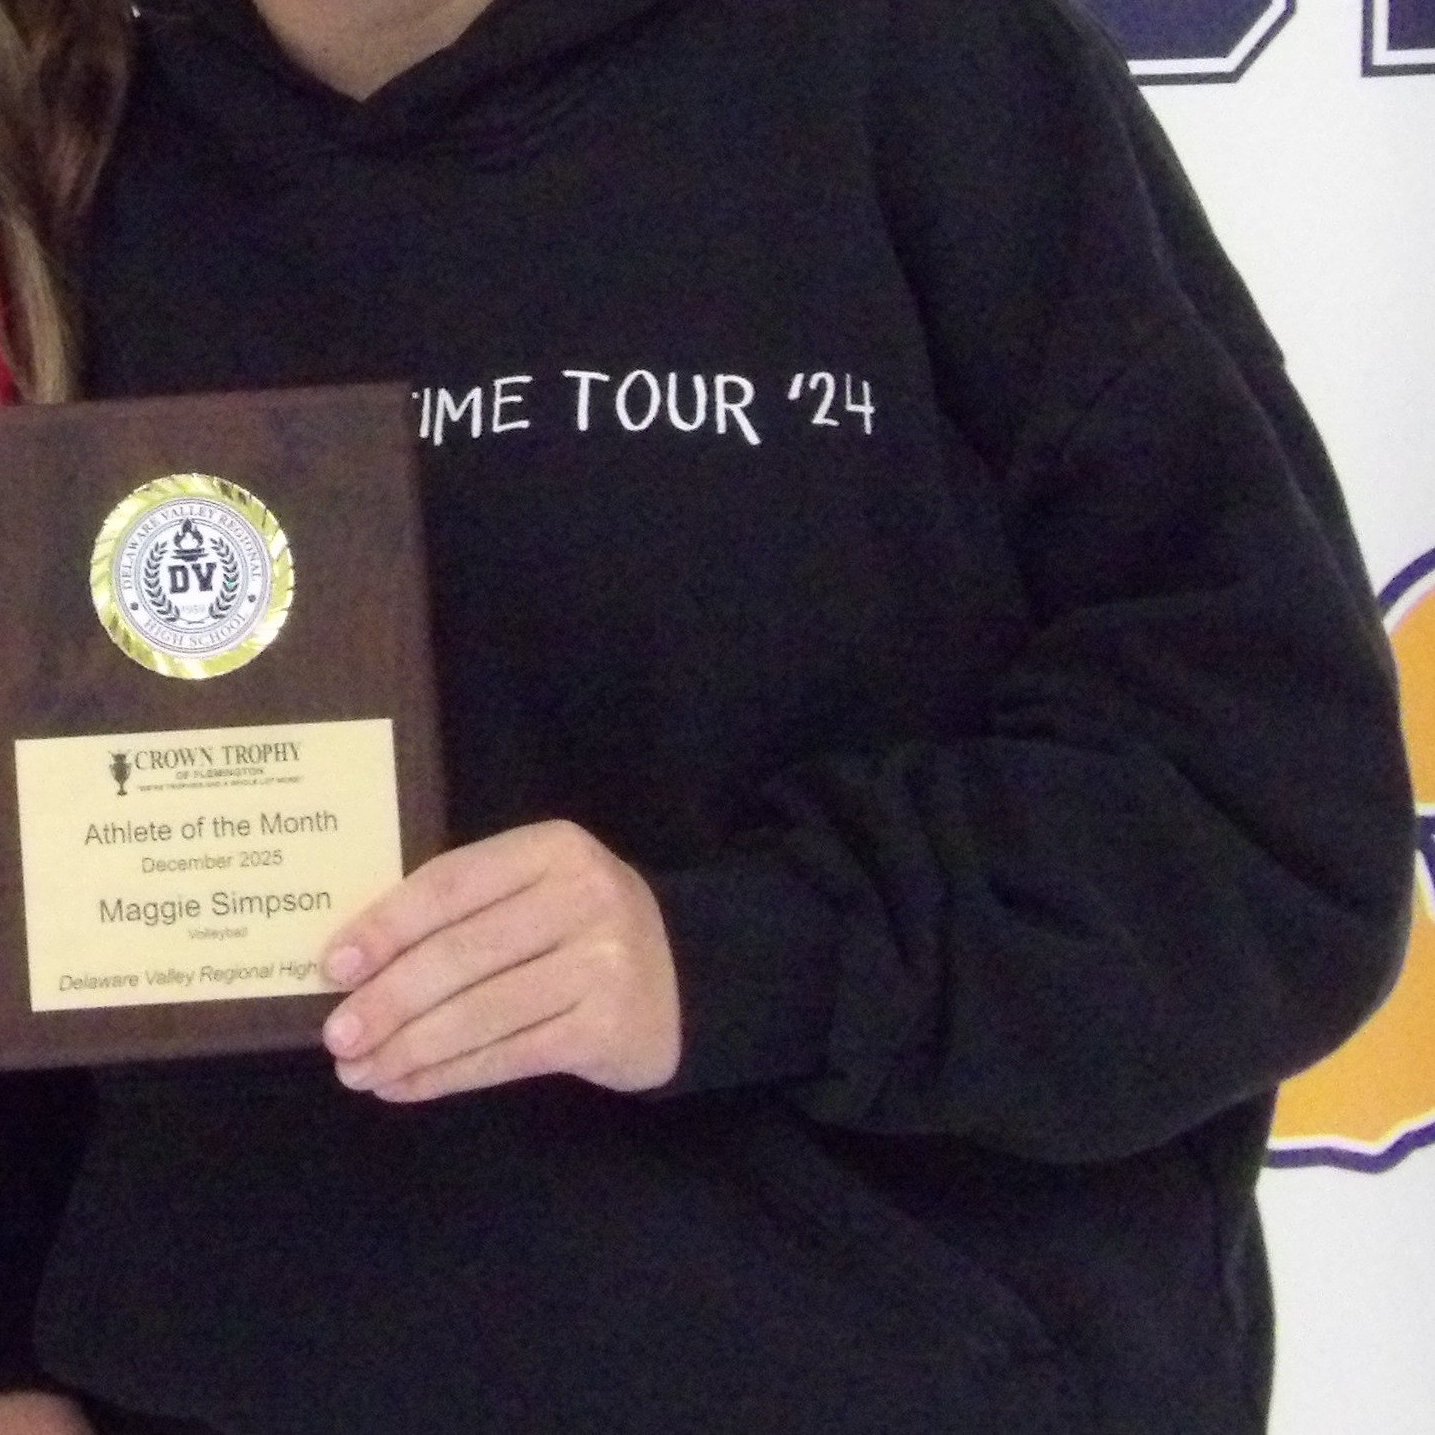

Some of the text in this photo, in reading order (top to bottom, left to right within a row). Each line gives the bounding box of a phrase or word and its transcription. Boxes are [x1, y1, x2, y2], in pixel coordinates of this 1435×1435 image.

[412, 369, 875, 446] IME TOUR '24
[122, 505, 263, 590] DELAWARE VALLEY REGIONAL
[167, 561, 217, 595] DV
[142, 613, 247, 648] HIGH SCHOOL
[134, 741, 301, 770] CROWN TROPHY
[84, 810, 338, 845] Athlete of the Month
[142, 849, 283, 874] December 2025
[100, 890, 332, 926] Maggie Simpson
[188, 926, 247, 941] Volleyball
[59, 974, 139, 992] Delaware
[145, 968, 194, 987] Valley
[200, 964, 274, 984] Regional
